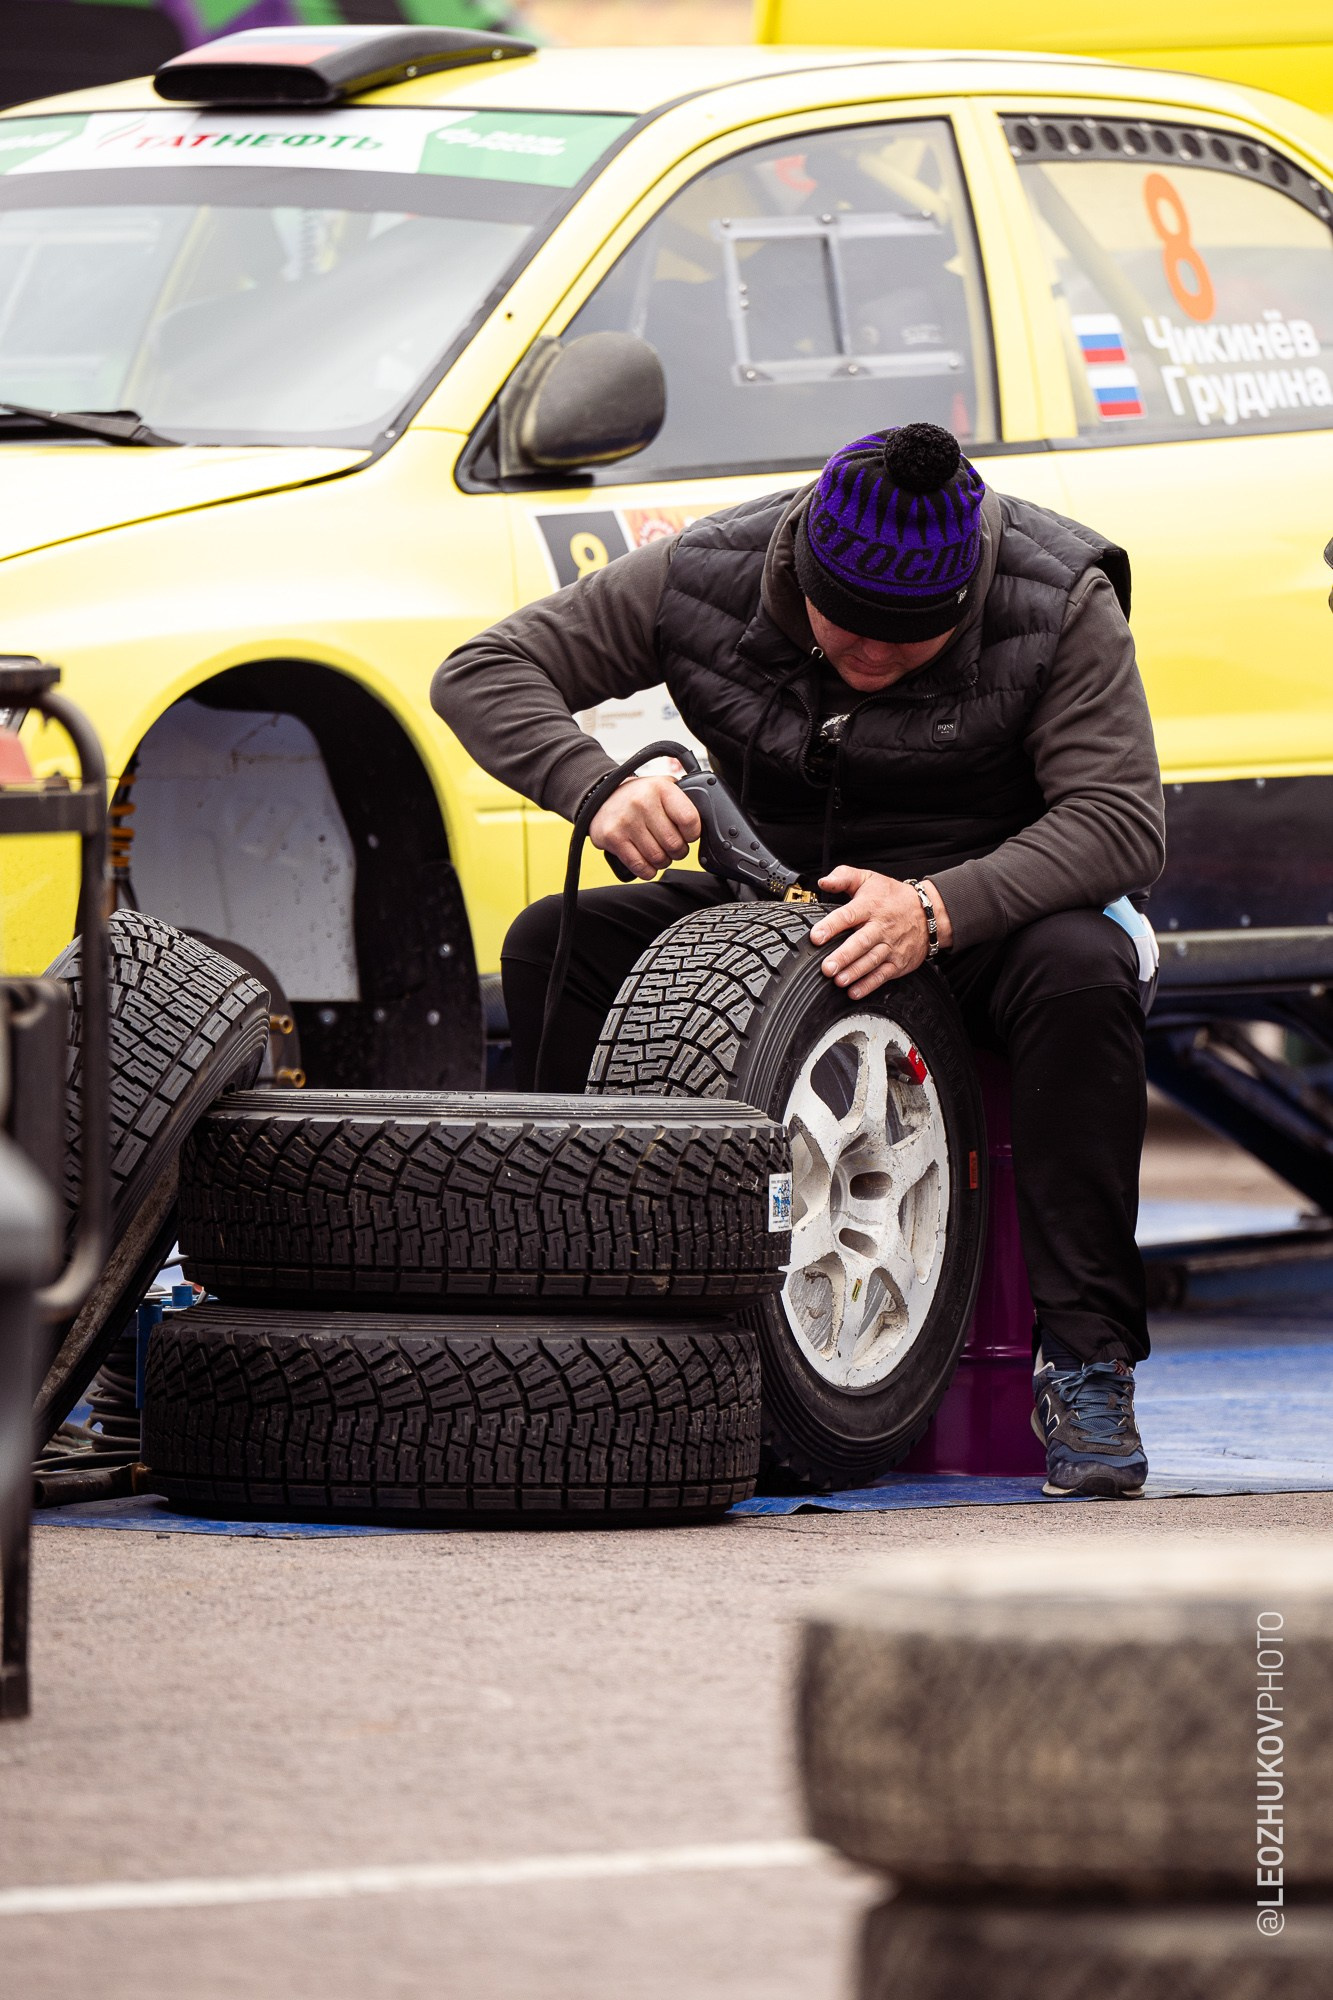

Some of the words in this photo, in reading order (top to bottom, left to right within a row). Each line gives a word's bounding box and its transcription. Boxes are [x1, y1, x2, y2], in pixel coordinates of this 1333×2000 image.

[134, 132, 385, 151] ТАТНЕФТЬ
[1142, 172, 1217, 324] 8
[1142, 309, 1321, 365] Чикинёв
[1160, 366, 1333, 426] Грудина
